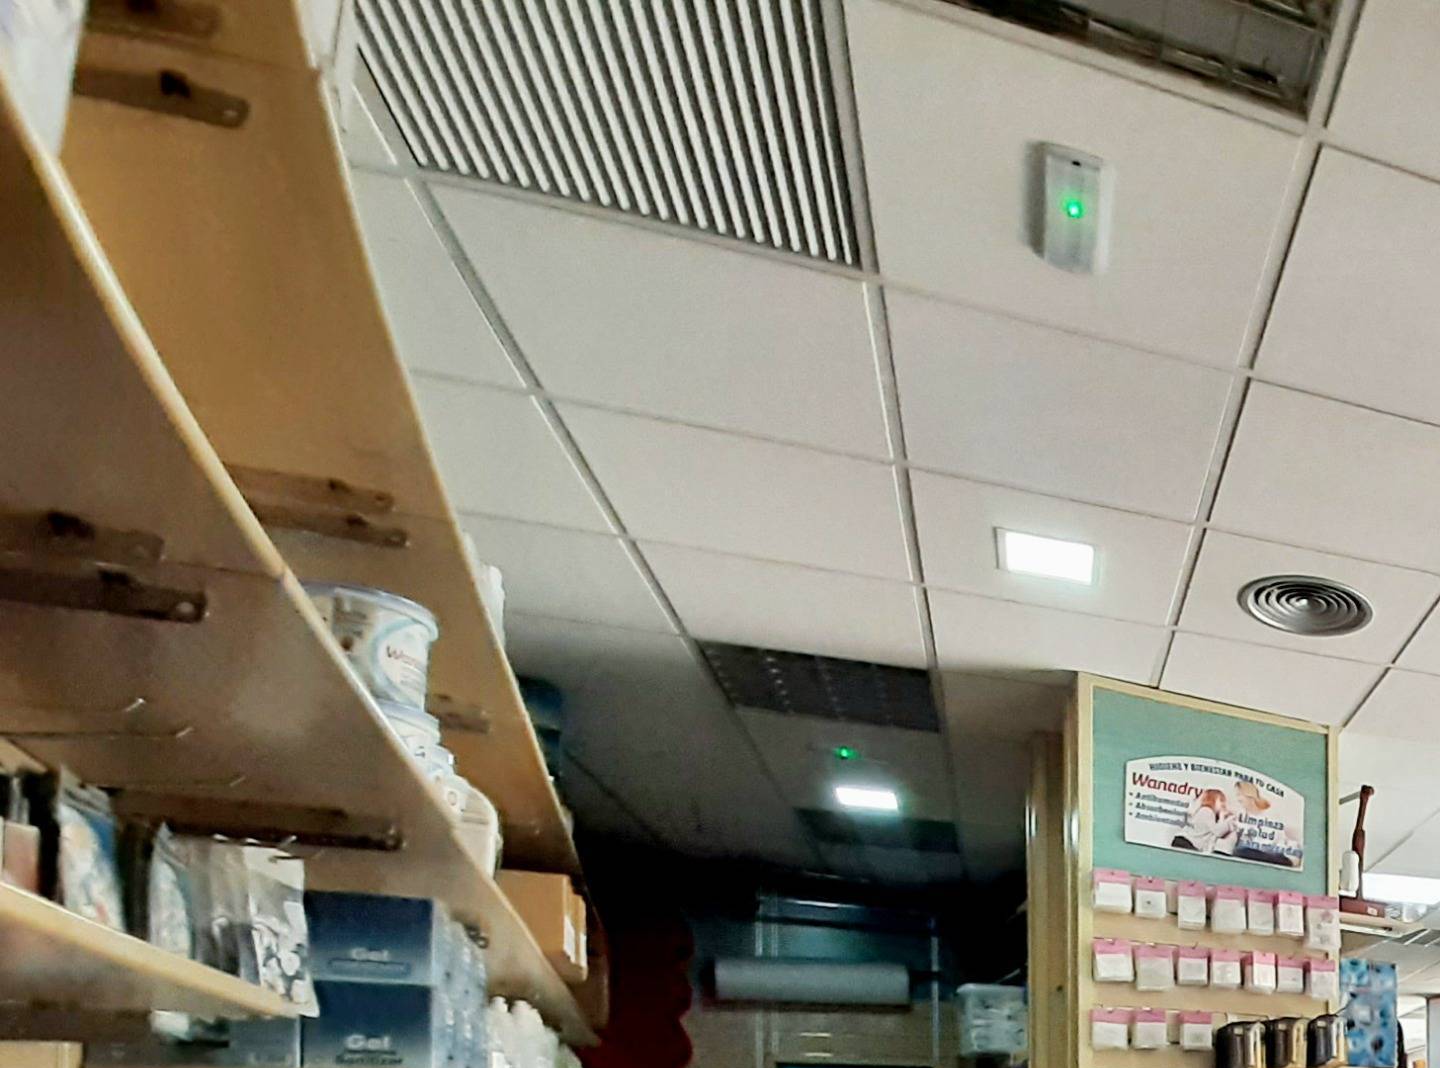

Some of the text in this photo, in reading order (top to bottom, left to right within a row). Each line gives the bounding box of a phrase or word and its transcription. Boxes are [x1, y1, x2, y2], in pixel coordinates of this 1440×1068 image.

[1132, 772, 1203, 799] Wanadry
[1266, 783, 1285, 798] CASA
[345, 1034, 391, 1050] Gel
